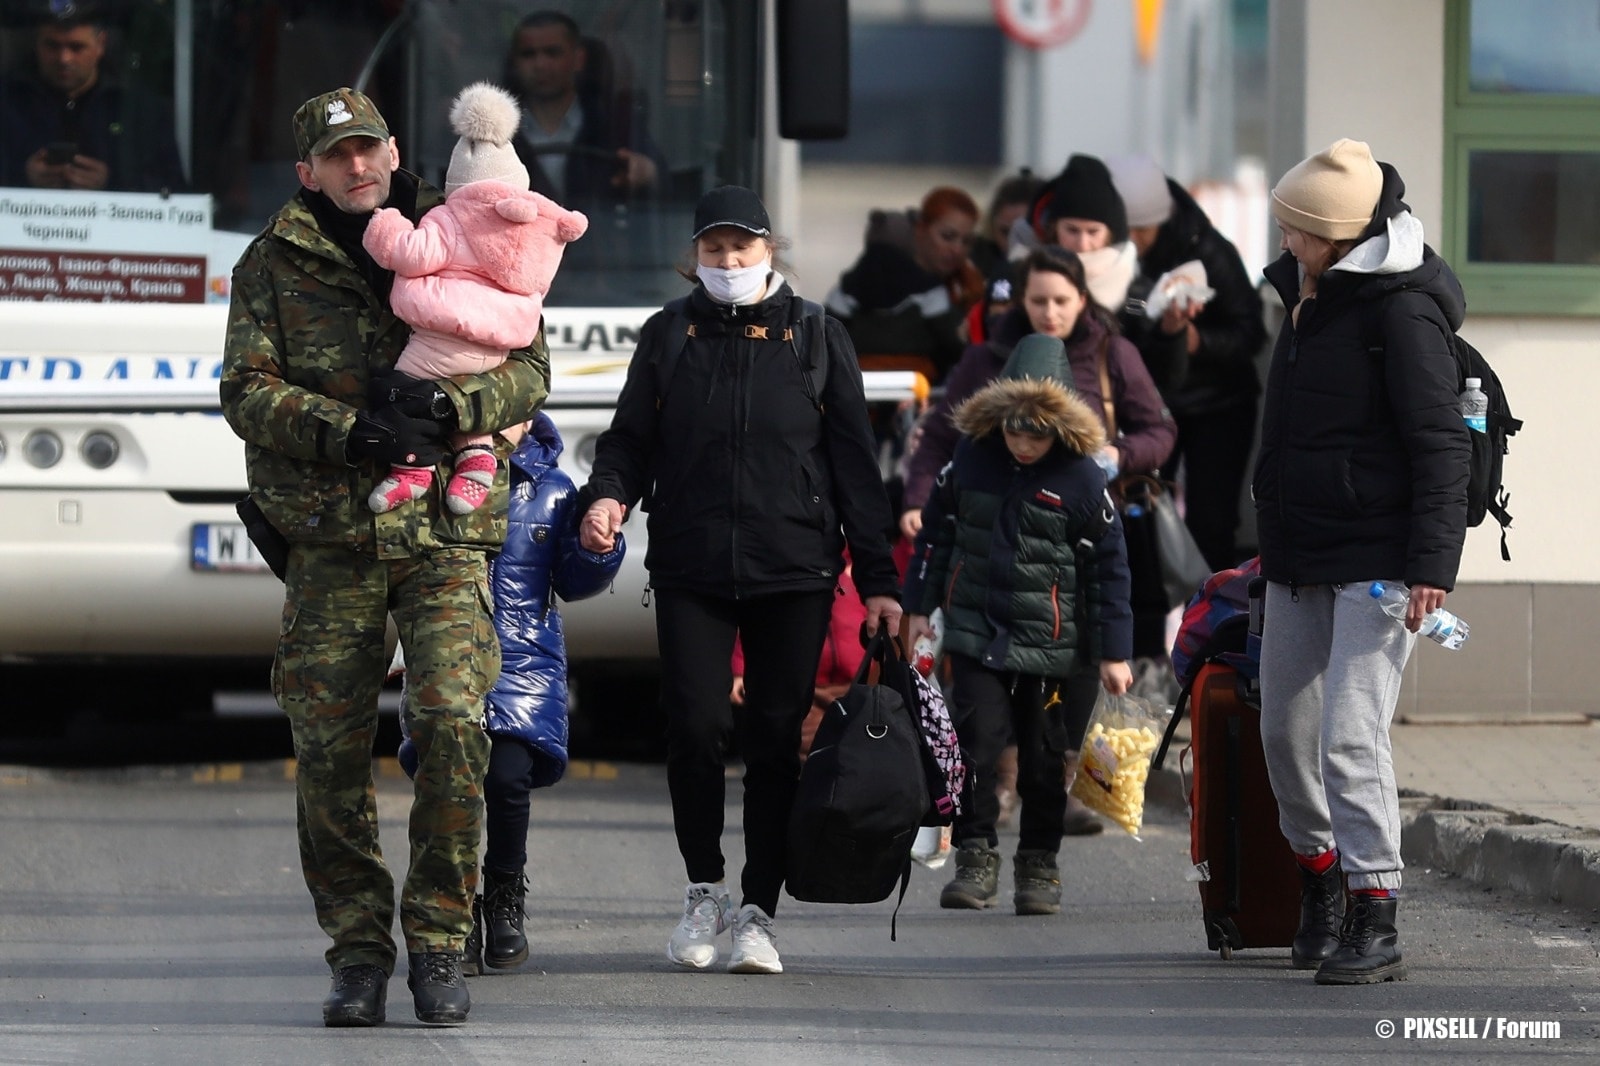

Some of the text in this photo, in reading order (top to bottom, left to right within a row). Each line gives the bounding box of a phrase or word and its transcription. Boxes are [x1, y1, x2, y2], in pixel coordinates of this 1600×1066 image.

[23, 222, 88, 241] Чернівці
[58, 255, 199, 280] Івано-Франківськ
[131, 278, 184, 298] Краків
